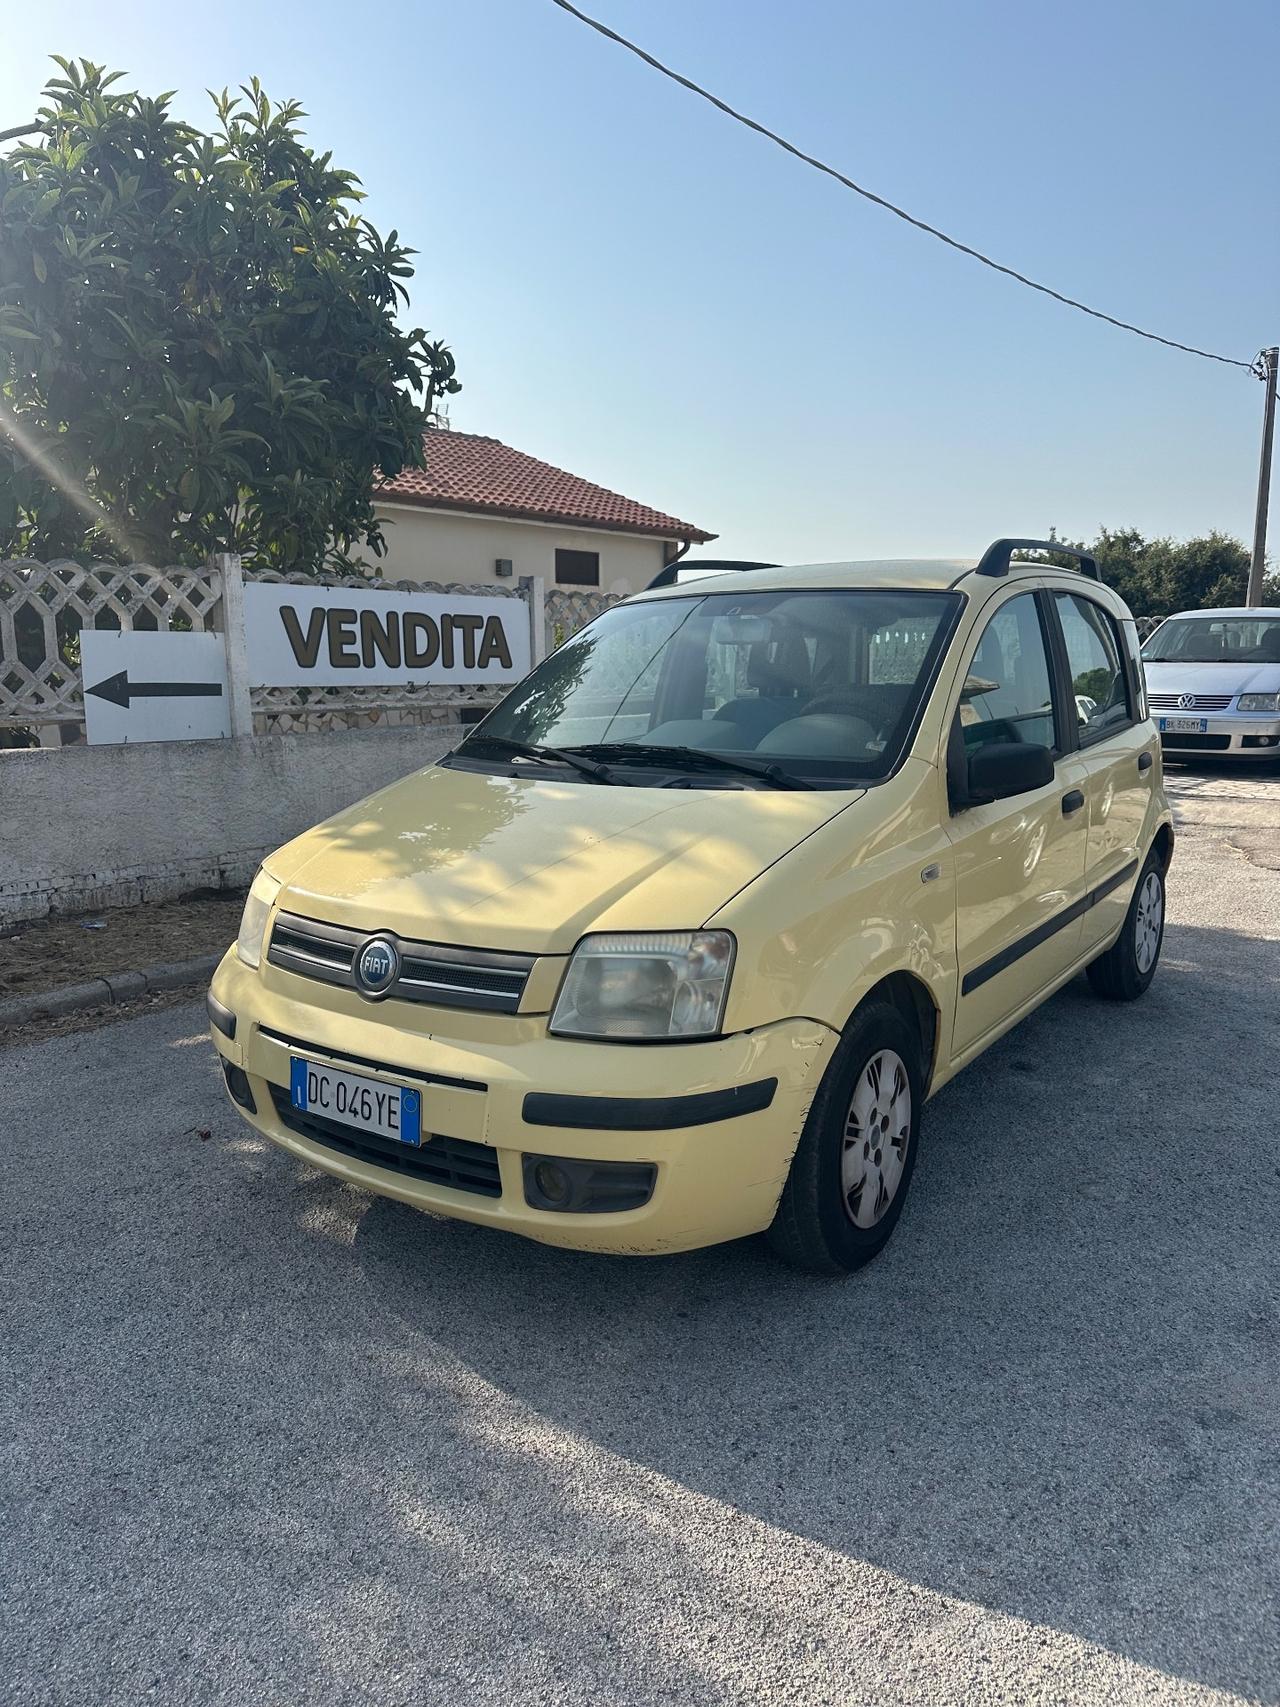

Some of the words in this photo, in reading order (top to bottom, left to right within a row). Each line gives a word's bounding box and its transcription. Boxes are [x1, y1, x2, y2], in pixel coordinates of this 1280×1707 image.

[279, 605, 513, 669] VENDITA
[364, 956, 388, 974] FIAT
[308, 1071, 330, 1108] DC
[336, 1081, 400, 1130] 046YE
